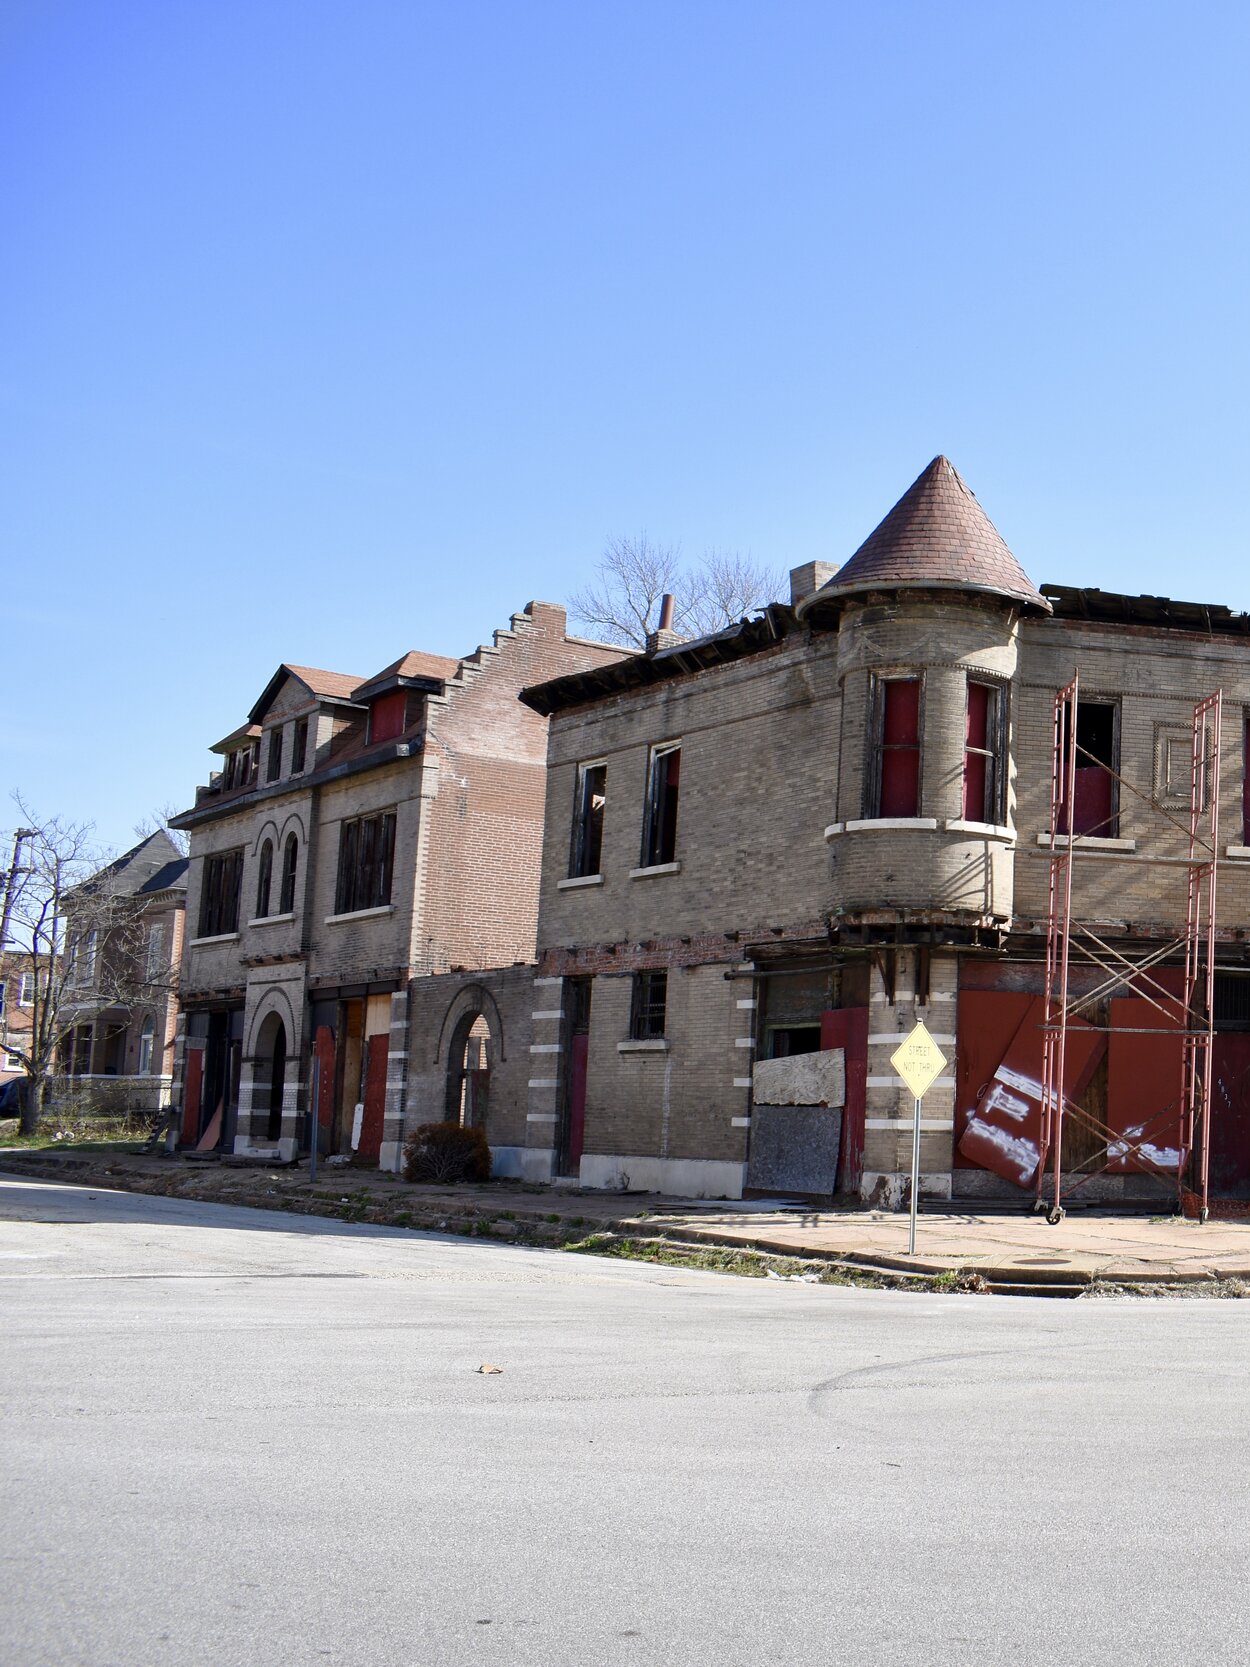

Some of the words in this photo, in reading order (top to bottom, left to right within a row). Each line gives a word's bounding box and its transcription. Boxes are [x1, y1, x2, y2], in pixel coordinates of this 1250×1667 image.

[908, 1045, 931, 1056] STREET
[903, 1061, 916, 1072] NOT
[919, 1062, 935, 1073] THRU
[1217, 1078, 1231, 1108] 437
